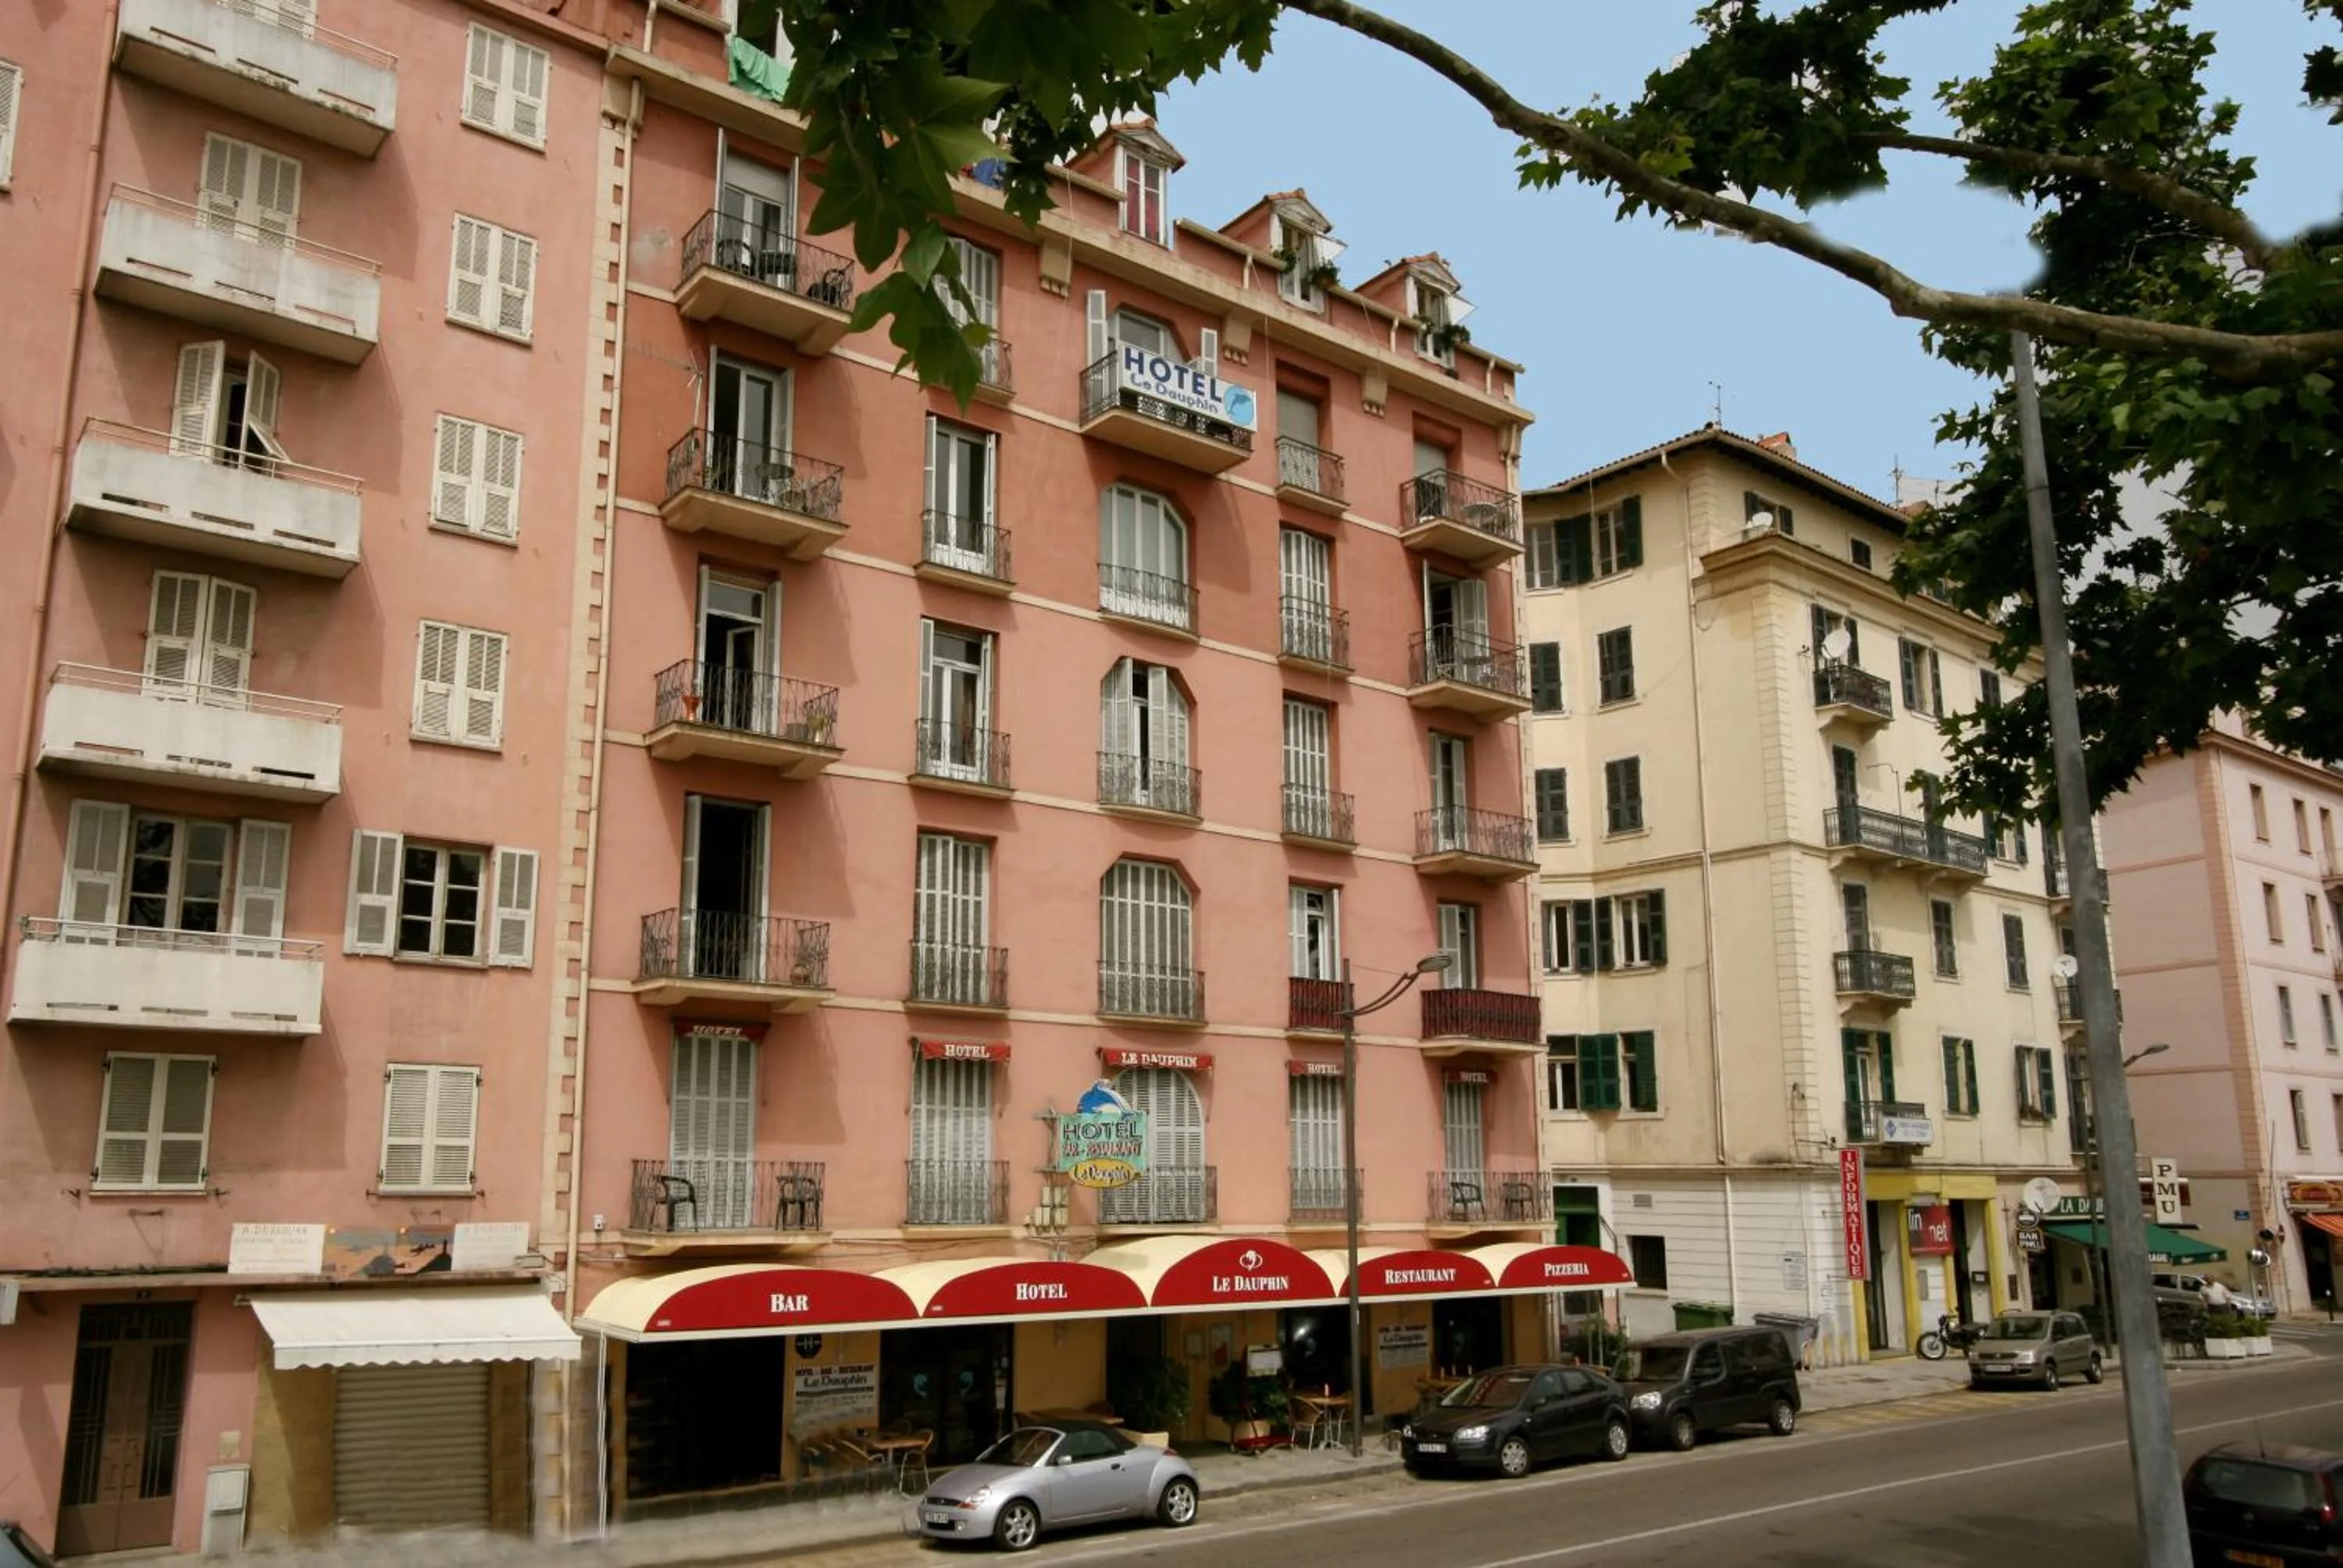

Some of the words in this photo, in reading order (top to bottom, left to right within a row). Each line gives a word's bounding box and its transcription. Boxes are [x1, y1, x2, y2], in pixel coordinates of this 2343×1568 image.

[1125, 347, 1223, 404] HOTEL
[1156, 382, 1219, 415] Dauphin
[944, 1044, 990, 1058] HOTEL
[1122, 1053, 1138, 1064] LE
[1141, 1053, 1197, 1067] DAUPHIN
[1307, 1064, 1342, 1075] HOTEL
[1063, 1121, 1142, 1141] HOTEL
[2157, 1164, 2177, 1213] PMU
[1844, 1152, 1862, 1276] INFORMATIQUE
[2060, 1199, 2074, 1213] LA
[1385, 1268, 1456, 1285] RESTAURANT
[1544, 1263, 1589, 1277] PIZZERIA
[1016, 1283, 1068, 1300] HOTEL
[1213, 1275, 1231, 1292] LE
[1235, 1275, 1289, 1291] DAUPHIN
[770, 1293, 809, 1313] BAR
